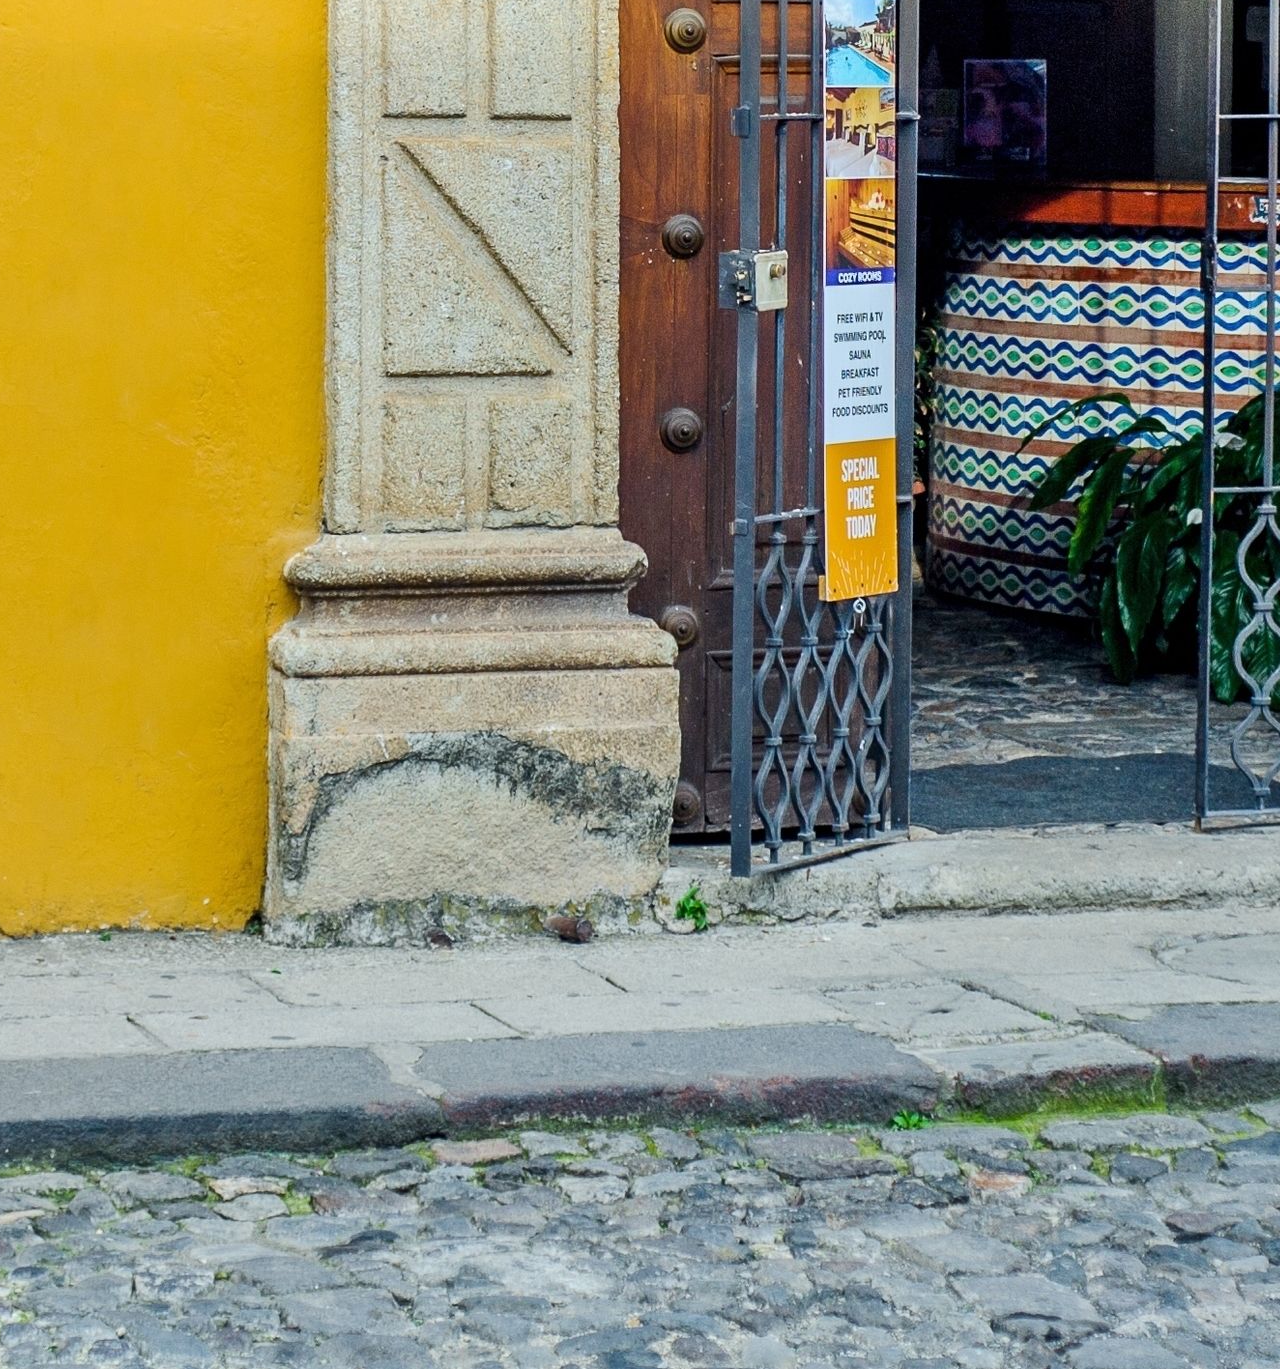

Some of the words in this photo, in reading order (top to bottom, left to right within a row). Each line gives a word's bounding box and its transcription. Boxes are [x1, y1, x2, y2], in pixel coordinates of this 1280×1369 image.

[838, 272, 857, 283] COZY
[858, 271, 882, 283] ROOMS
[837, 314, 853, 324] FREE
[855, 312, 868, 323] WIFI
[869, 312, 874, 322] &
[875, 312, 883, 322] TV
[834, 331, 867, 343] SWIMMING
[869, 330, 886, 342] POOL
[849, 350, 871, 360] SAUNA
[841, 367, 879, 379] BREAKFAST
[838, 388, 850, 399] PET
[852, 385, 882, 397] FRIENDLY
[832, 406, 850, 418] FOOD
[852, 403, 888, 416] DISCOUNTS
[841, 456, 880, 482] SPECIAL
[847, 486, 874, 511] PRICE
[846, 514, 877, 539] TODAY
